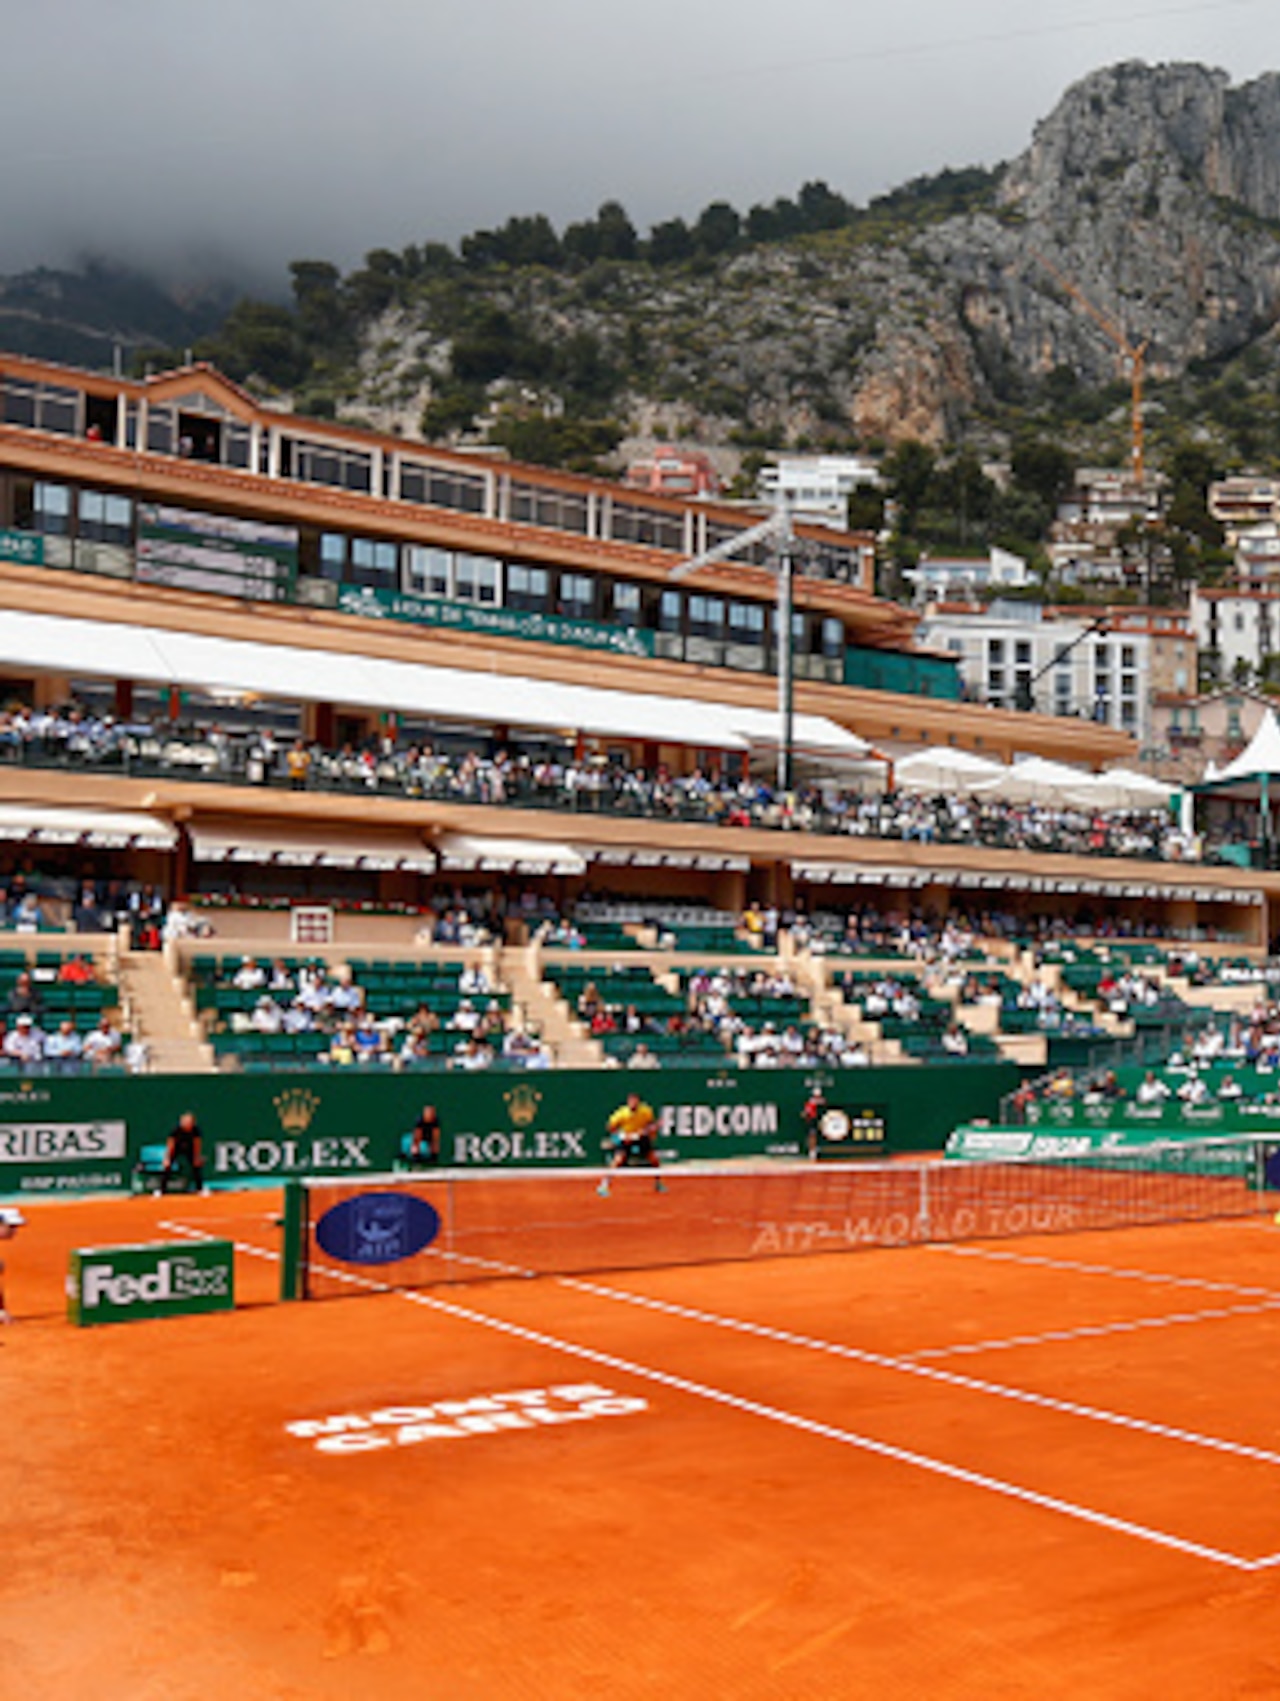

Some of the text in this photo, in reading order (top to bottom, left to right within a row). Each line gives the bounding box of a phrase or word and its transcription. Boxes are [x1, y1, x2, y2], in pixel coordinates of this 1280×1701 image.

[660, 1104, 778, 1136] FEDCOM
[214, 1137, 371, 1171] ROLEX
[453, 1130, 587, 1162] ROLEX
[752, 1204, 1074, 1252] ATP WORLD TOUR
[285, 1383, 615, 1437] MONTE
[314, 1398, 648, 1452] CARLO
